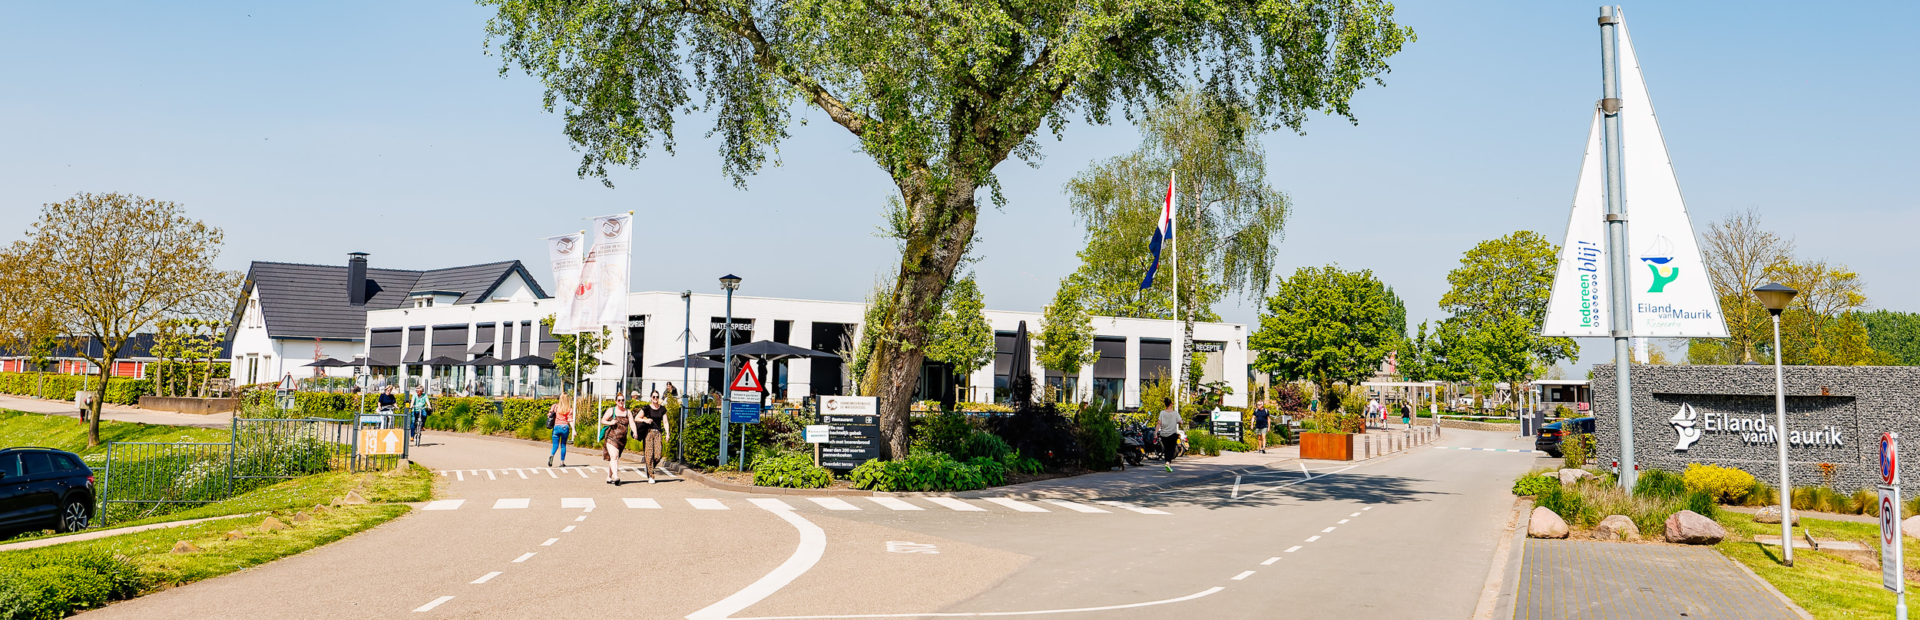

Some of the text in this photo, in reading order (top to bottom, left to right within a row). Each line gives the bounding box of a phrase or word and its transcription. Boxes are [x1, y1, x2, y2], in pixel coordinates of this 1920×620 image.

[1577, 240, 1602, 327] Iedereen blij!
[1638, 303, 1671, 313] Eiland
[1672, 309, 1712, 319] Maurik
[628, 320, 645, 328] SPIEGEL
[711, 322, 754, 331] WATESPIEGEL
[1704, 413, 1767, 432] Eiland
[1742, 432, 1768, 443] van
[364, 437, 378, 454] 19
